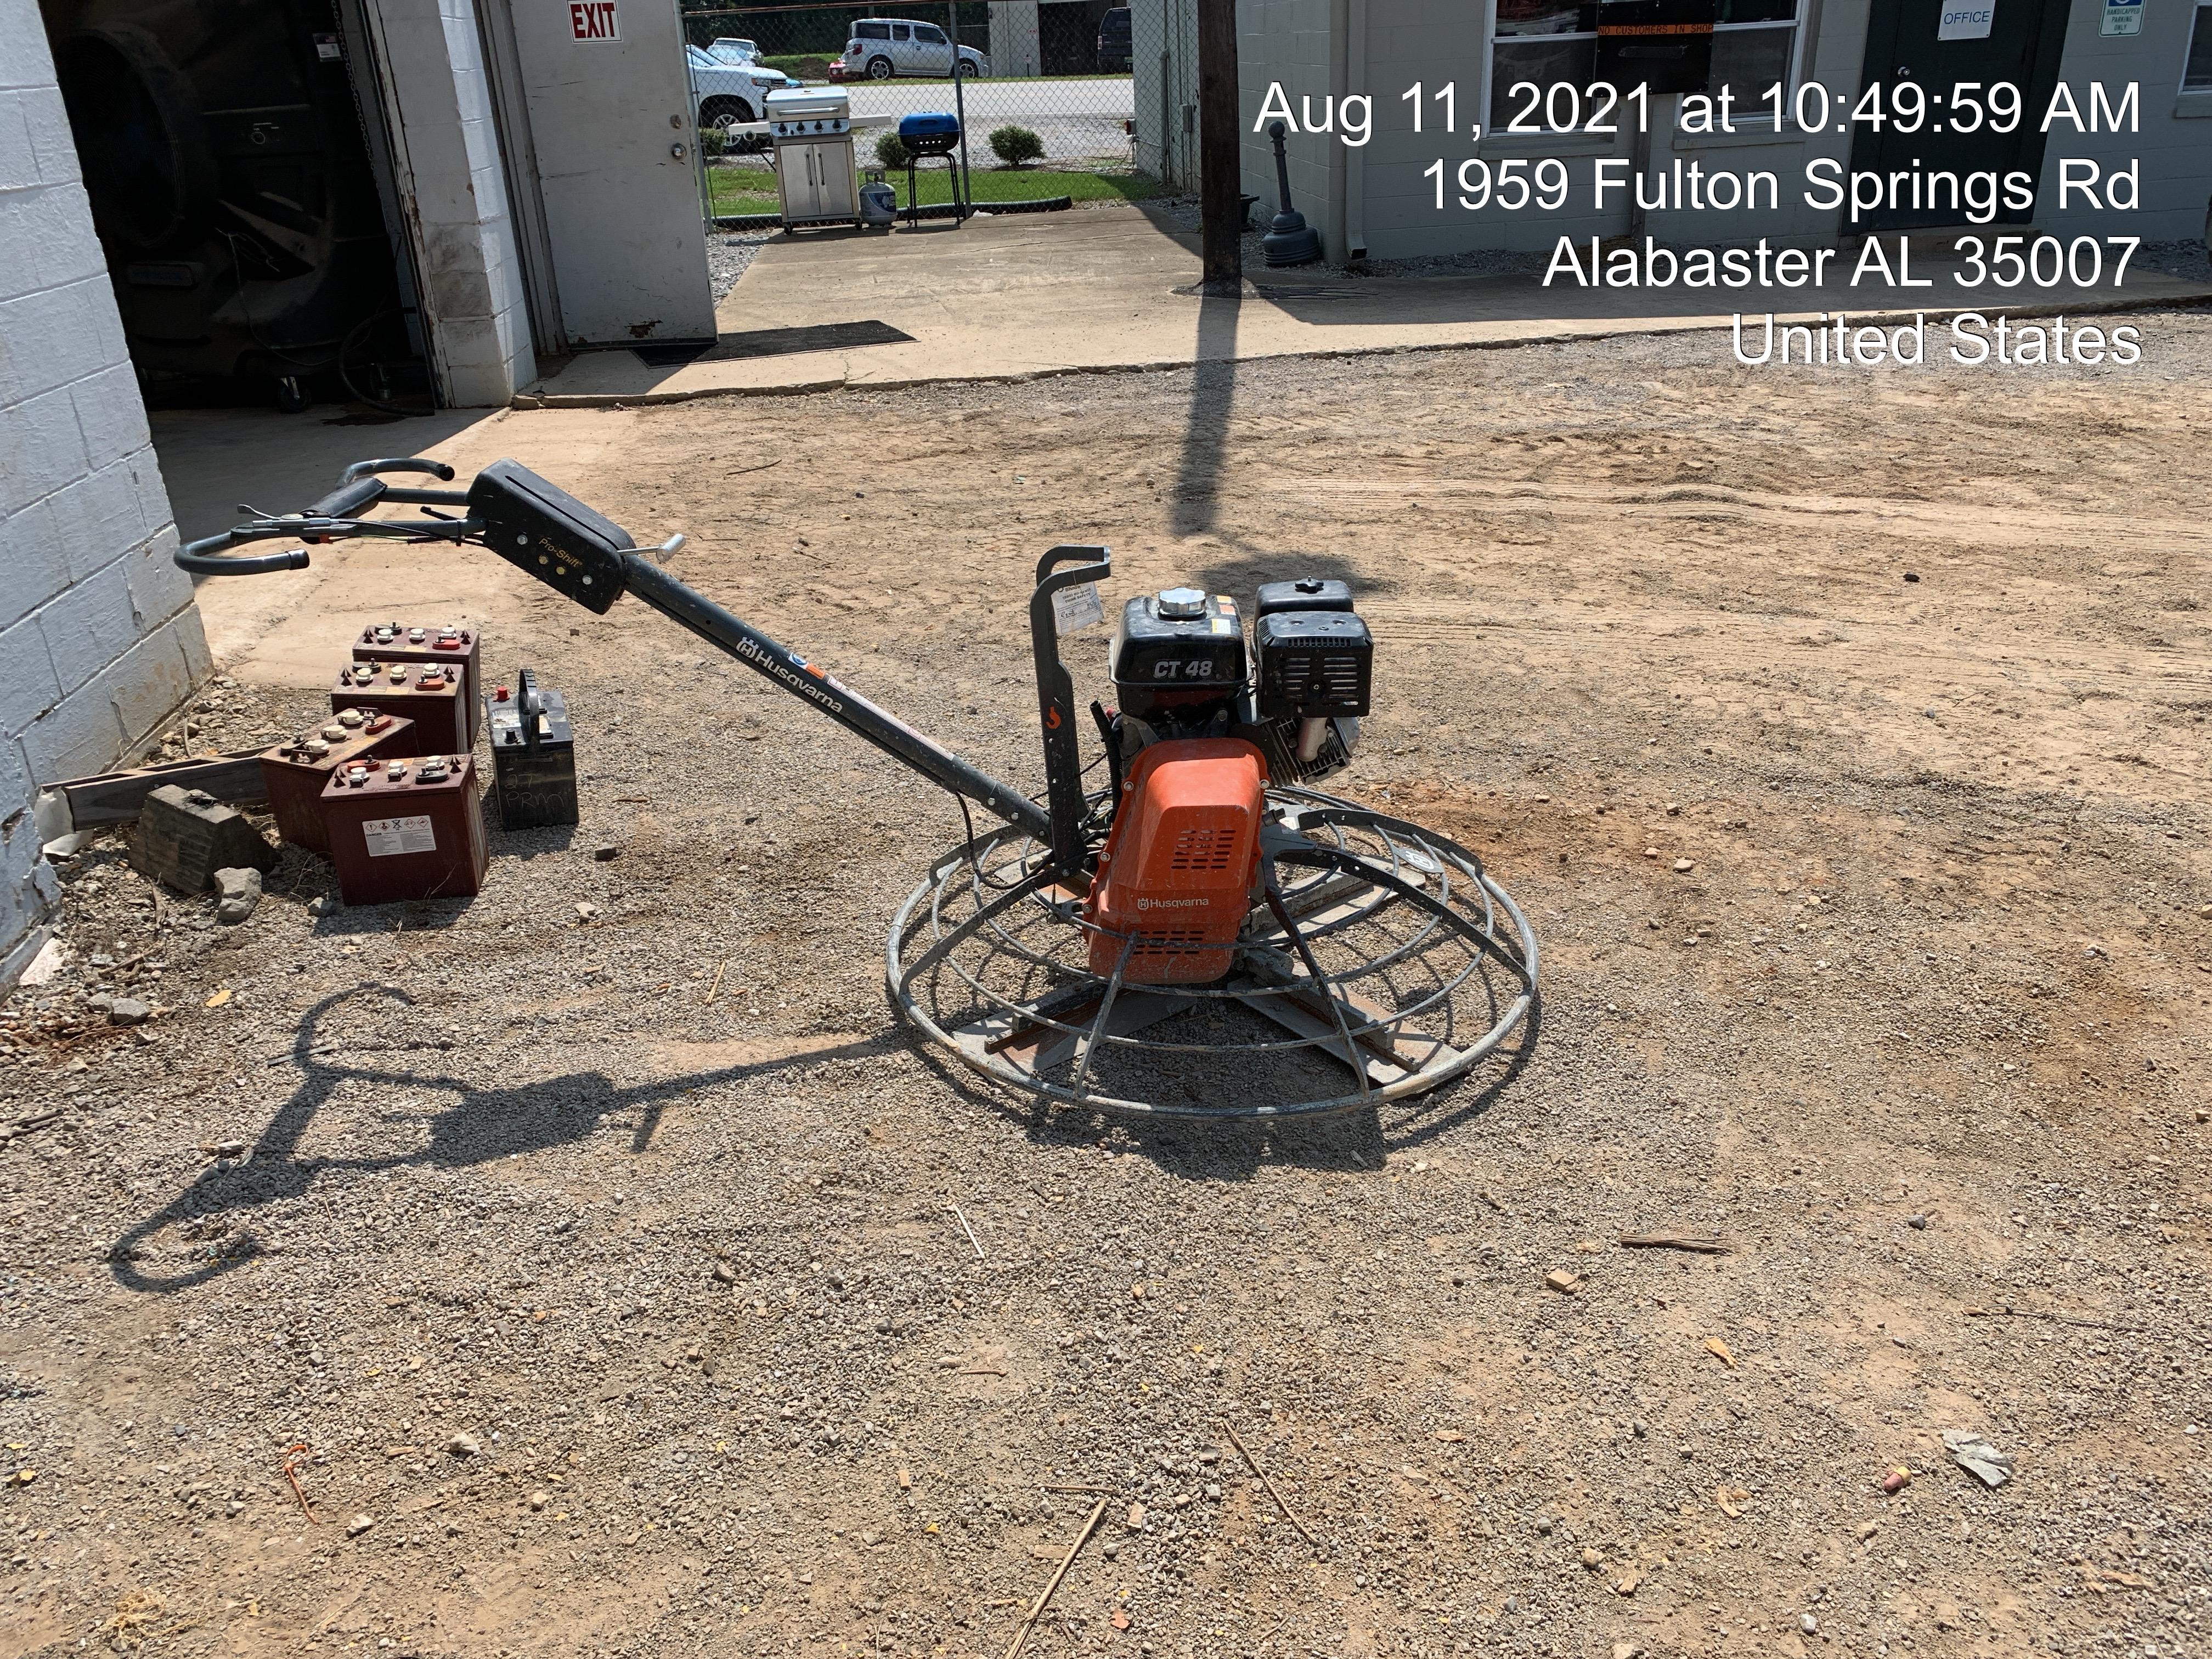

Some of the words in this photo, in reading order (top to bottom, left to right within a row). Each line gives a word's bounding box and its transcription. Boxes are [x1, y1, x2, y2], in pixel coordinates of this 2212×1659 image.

[570, 2, 615, 38] EXIT
[1944, 11, 1990, 24] OFFICE
[1598, 26, 1610, 35] NO
[1616, 25, 1668, 35] CUSTOMERS
[1674, 25, 1685, 33] IN
[1690, 24, 1714, 33] SHOP
[1153, 661, 1181, 679] CT
[1185, 660, 1213, 677] 48
[754, 650, 843, 713] Husqvarna
[1149, 898, 1209, 909] Husqvarna
